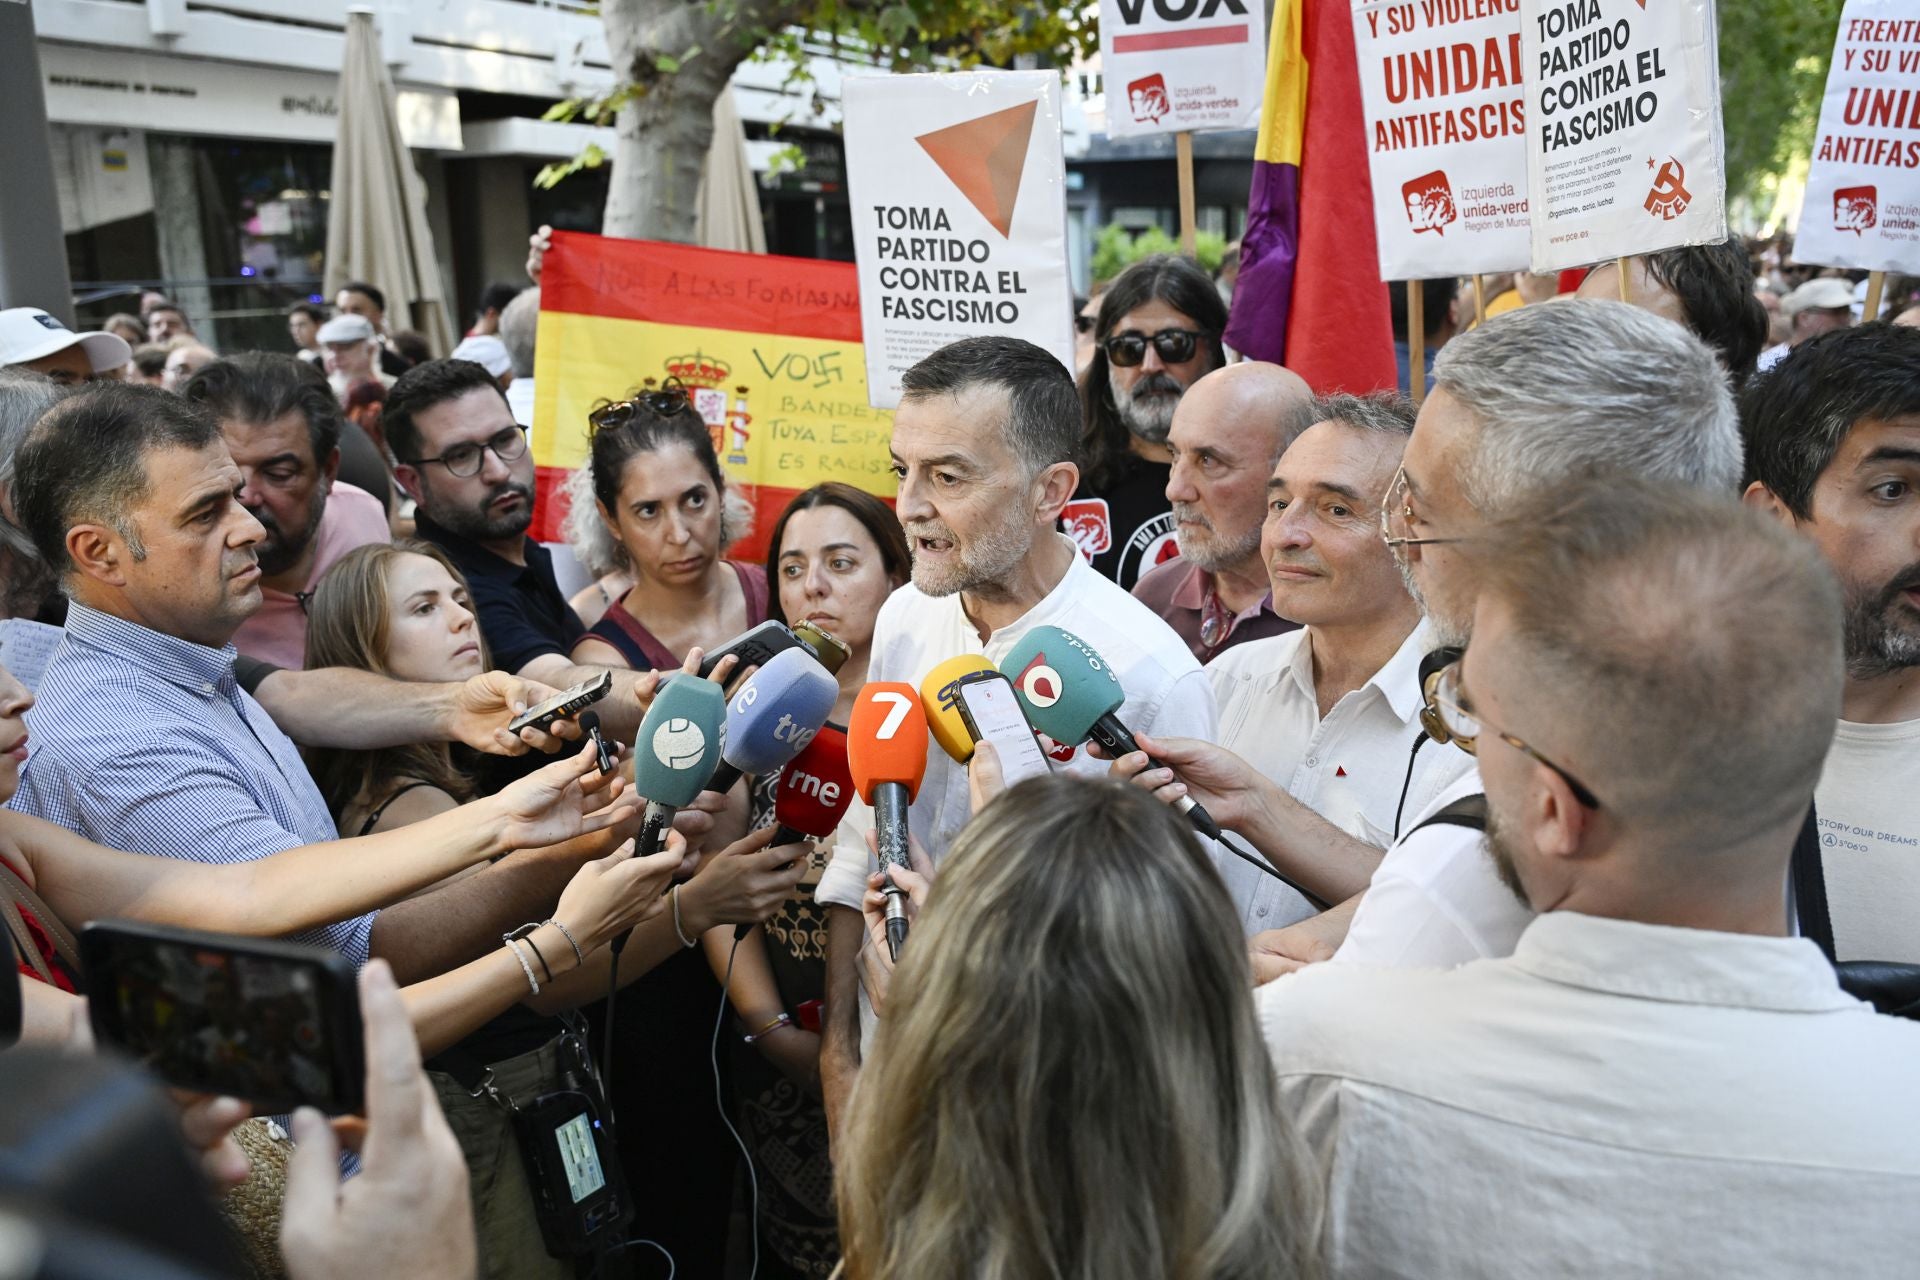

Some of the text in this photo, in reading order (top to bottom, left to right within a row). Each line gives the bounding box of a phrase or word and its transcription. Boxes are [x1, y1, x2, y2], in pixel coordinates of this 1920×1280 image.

[1366, 11, 1378, 39] Y
[1387, 4, 1415, 36] SU
[1537, 0, 1602, 43] TOMA
[1540, 18, 1630, 81] PARTIDO
[1844, 48, 1920, 73] Y SU VI
[1540, 47, 1666, 116] CONTRA EL
[1374, 99, 1525, 152] ANTIFASCIS
[1542, 90, 1657, 153] FASCISMO
[1818, 135, 1920, 169] ANTIFAS
[1461, 182, 1514, 202] izquierda
[874, 206, 952, 231] TOMA
[1463, 198, 1528, 218] unida-verd
[1651, 198, 1687, 221] PCE
[1465, 220, 1493, 232] Región
[1494, 219, 1504, 229] de
[1550, 230, 1589, 244] www.pce.es
[877, 236, 990, 263] PARTIDO
[663, 270, 680, 295] A
[690, 273, 737, 299] LAS
[880, 266, 1027, 294] CONTRA EL
[882, 297, 1019, 324] FASCISMO
[778, 453, 804, 470] ES
[871, 691, 913, 740] 7
[773, 713, 816, 751] tve
[788, 769, 841, 807] rne
[1852, 827, 1874, 838] OUR
[1877, 832, 1918, 846] DREAMS
